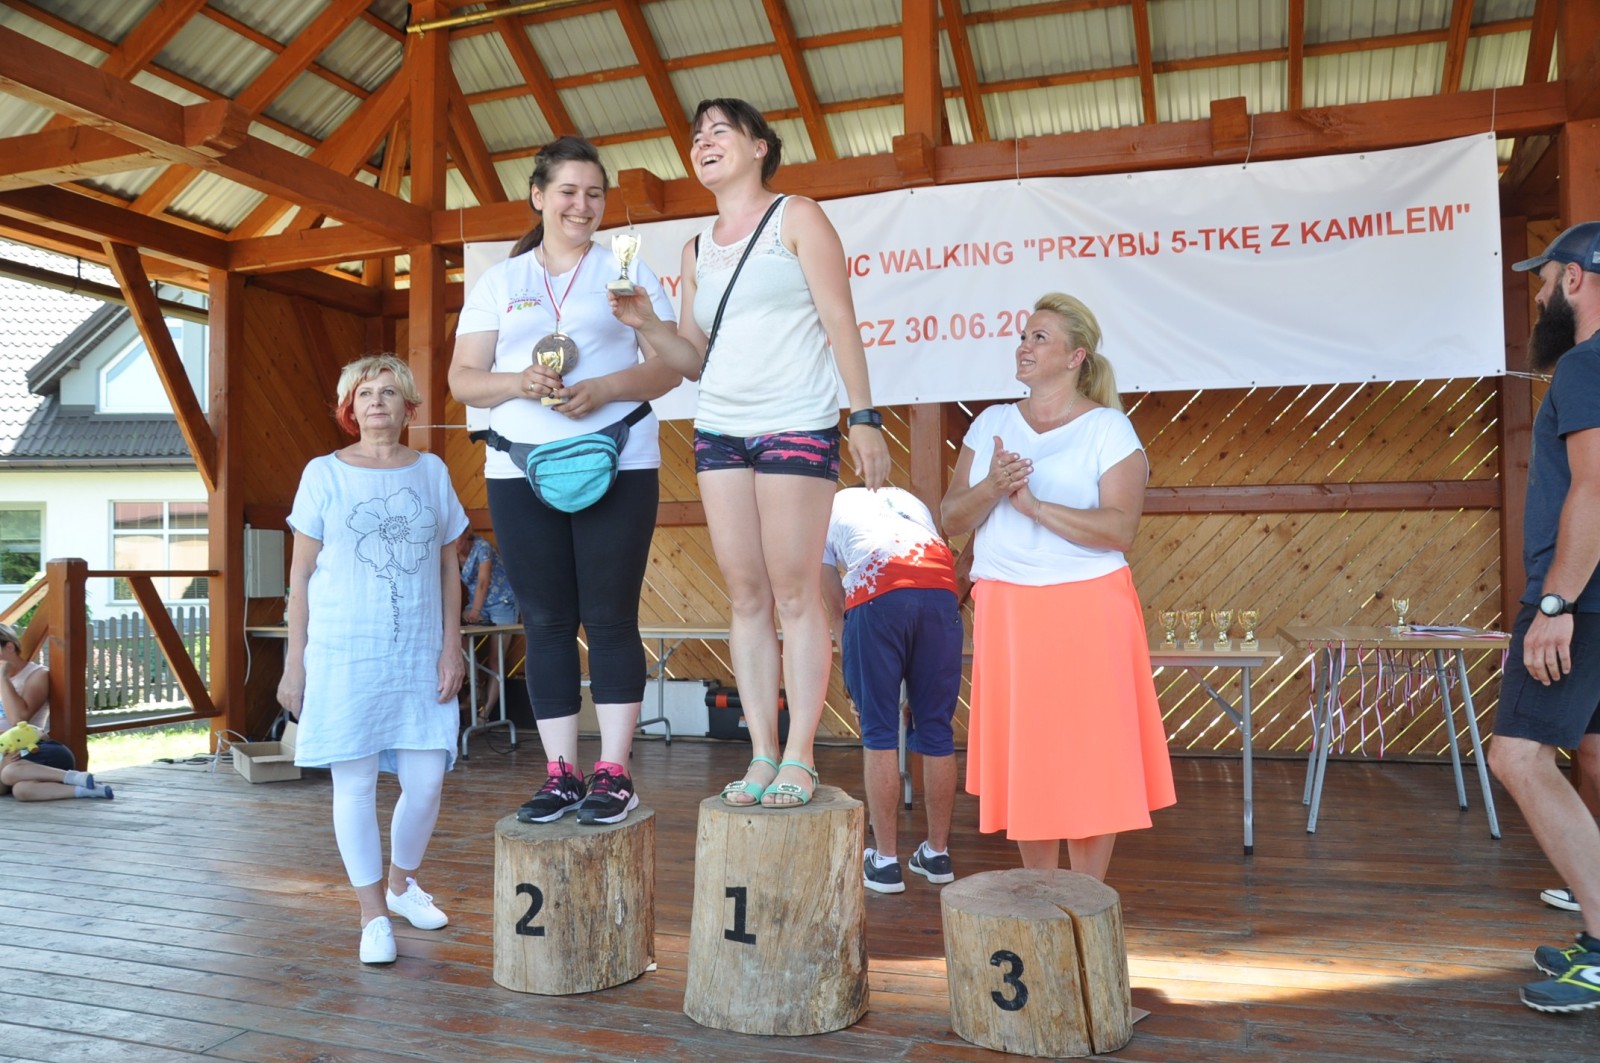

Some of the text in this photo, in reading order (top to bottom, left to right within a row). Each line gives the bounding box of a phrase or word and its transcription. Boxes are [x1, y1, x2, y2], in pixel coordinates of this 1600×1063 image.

[847, 203, 1472, 279] IC WALKING "PRZYBIJ 5-TKĘ Z KAMILEM"
[856, 309, 1030, 348] CZ 30.06.20
[515, 883, 545, 937] 2
[724, 886, 757, 945] 1
[990, 949, 1029, 1012] 3
